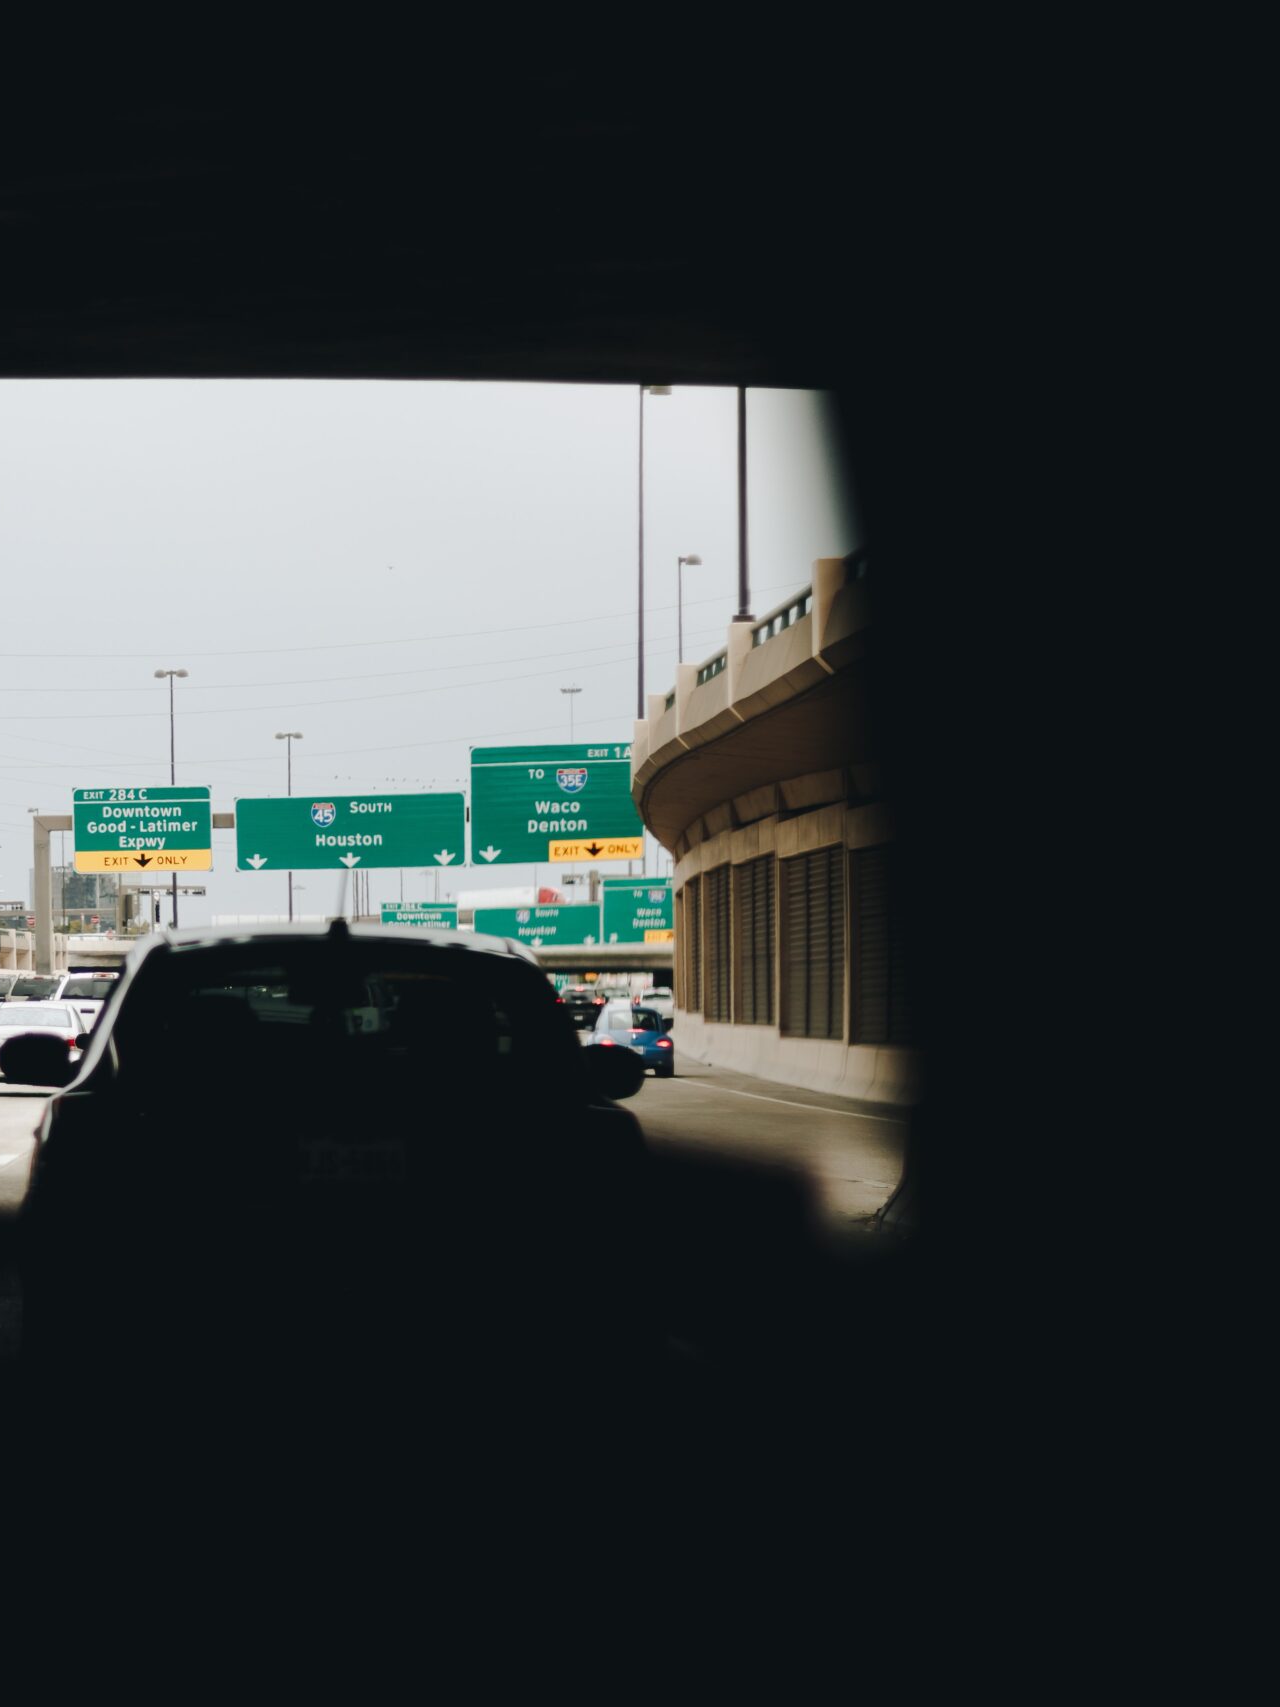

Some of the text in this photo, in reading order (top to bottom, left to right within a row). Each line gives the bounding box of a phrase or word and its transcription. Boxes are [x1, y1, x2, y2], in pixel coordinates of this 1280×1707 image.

[587, 748, 609, 758] EXIT
[528, 768, 545, 780] TO
[560, 774, 583, 787] 35E
[83, 791, 104, 800] EXIT
[102, 806, 182, 818] Downtown
[535, 801, 581, 815] Waco
[314, 808, 333, 823] 45
[527, 818, 588, 833] Denton
[118, 836, 166, 850] Expwy
[315, 833, 383, 847] Houston
[554, 844, 639, 857] EXIT ONLY
[104, 856, 188, 866] EXIT ONLY
